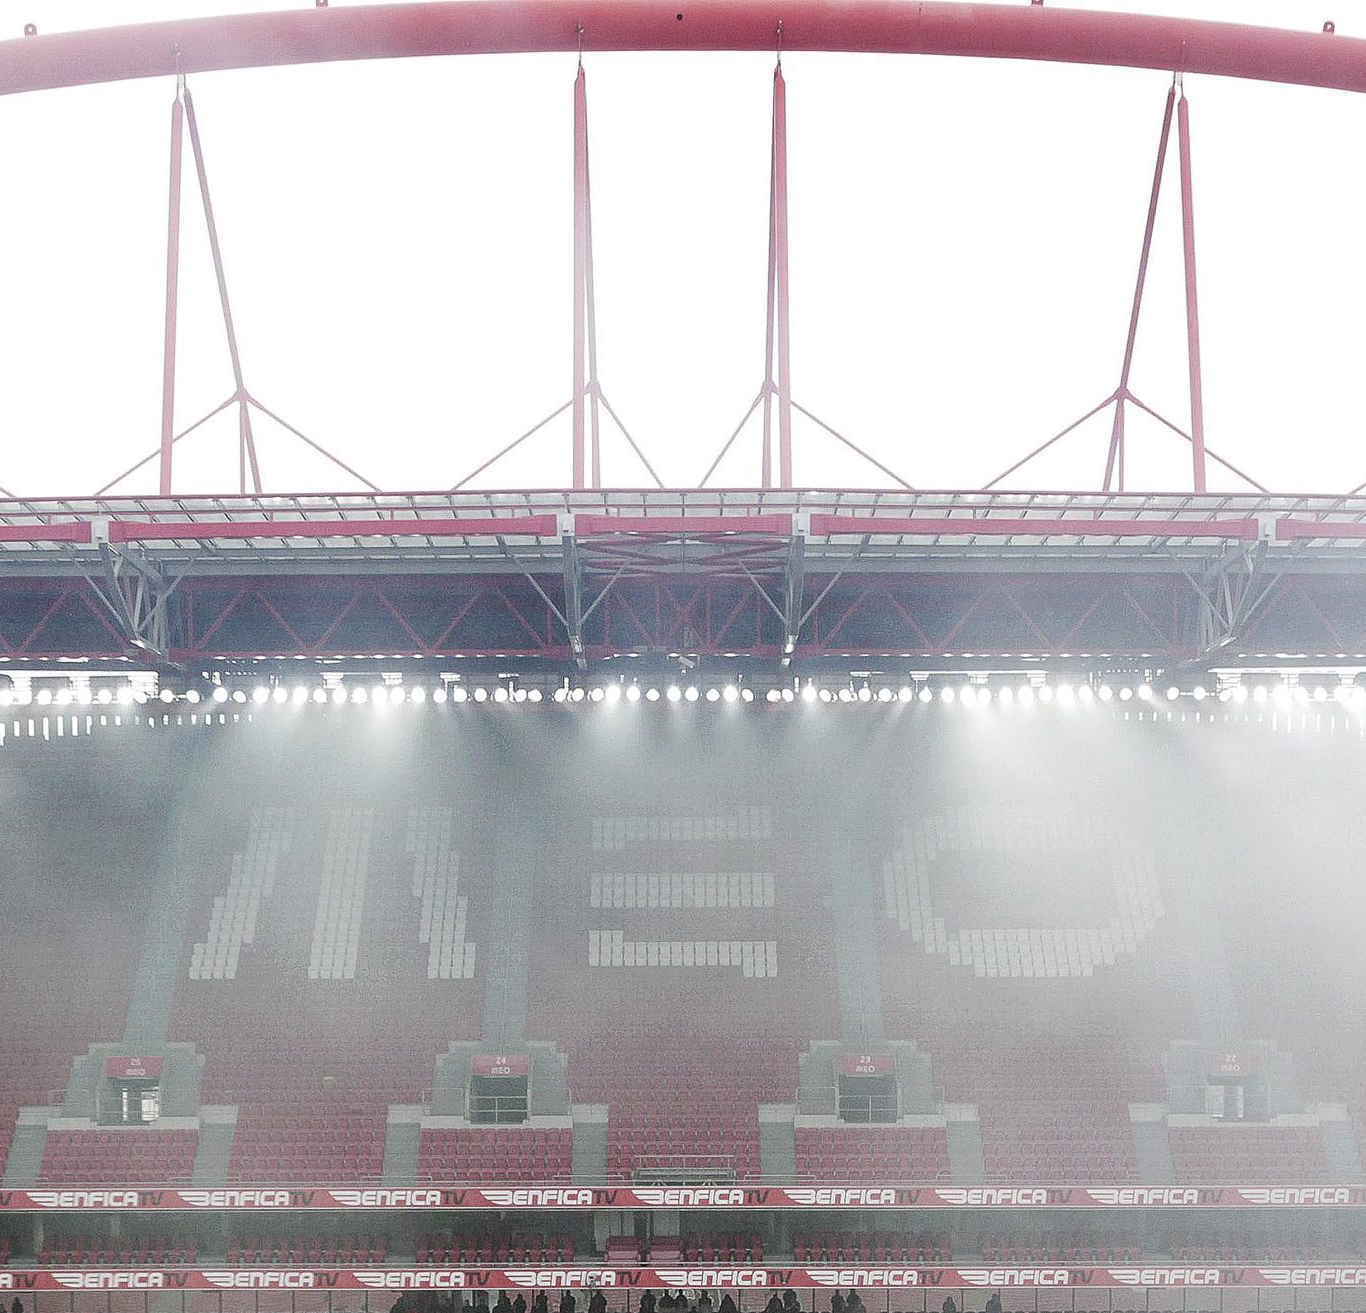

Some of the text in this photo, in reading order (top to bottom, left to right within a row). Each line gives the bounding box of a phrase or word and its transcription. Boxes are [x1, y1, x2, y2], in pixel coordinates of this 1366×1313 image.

[26, 1192, 139, 1208] BENFICA
[178, 1191, 289, 1207] BENFICA
[328, 1191, 441, 1206] BENFICA
[480, 1190, 592, 1205] BENFICA
[632, 1190, 744, 1205] BENFICA
[782, 1189, 895, 1205] BENFICA
[935, 1189, 1047, 1205] BENFICA
[1086, 1189, 1198, 1204] BENFICA
[1237, 1188, 1349, 1204] BENFICA
[51, 1273, 164, 1288] BENFICA
[201, 1272, 314, 1287] BENFICA
[353, 1272, 465, 1287] BENFICA
[655, 1271, 767, 1286] BENFICA
[806, 1270, 918, 1285] BENFICA
[956, 1270, 1069, 1285] BENFICA
[1108, 1269, 1219, 1284] BENFICA
